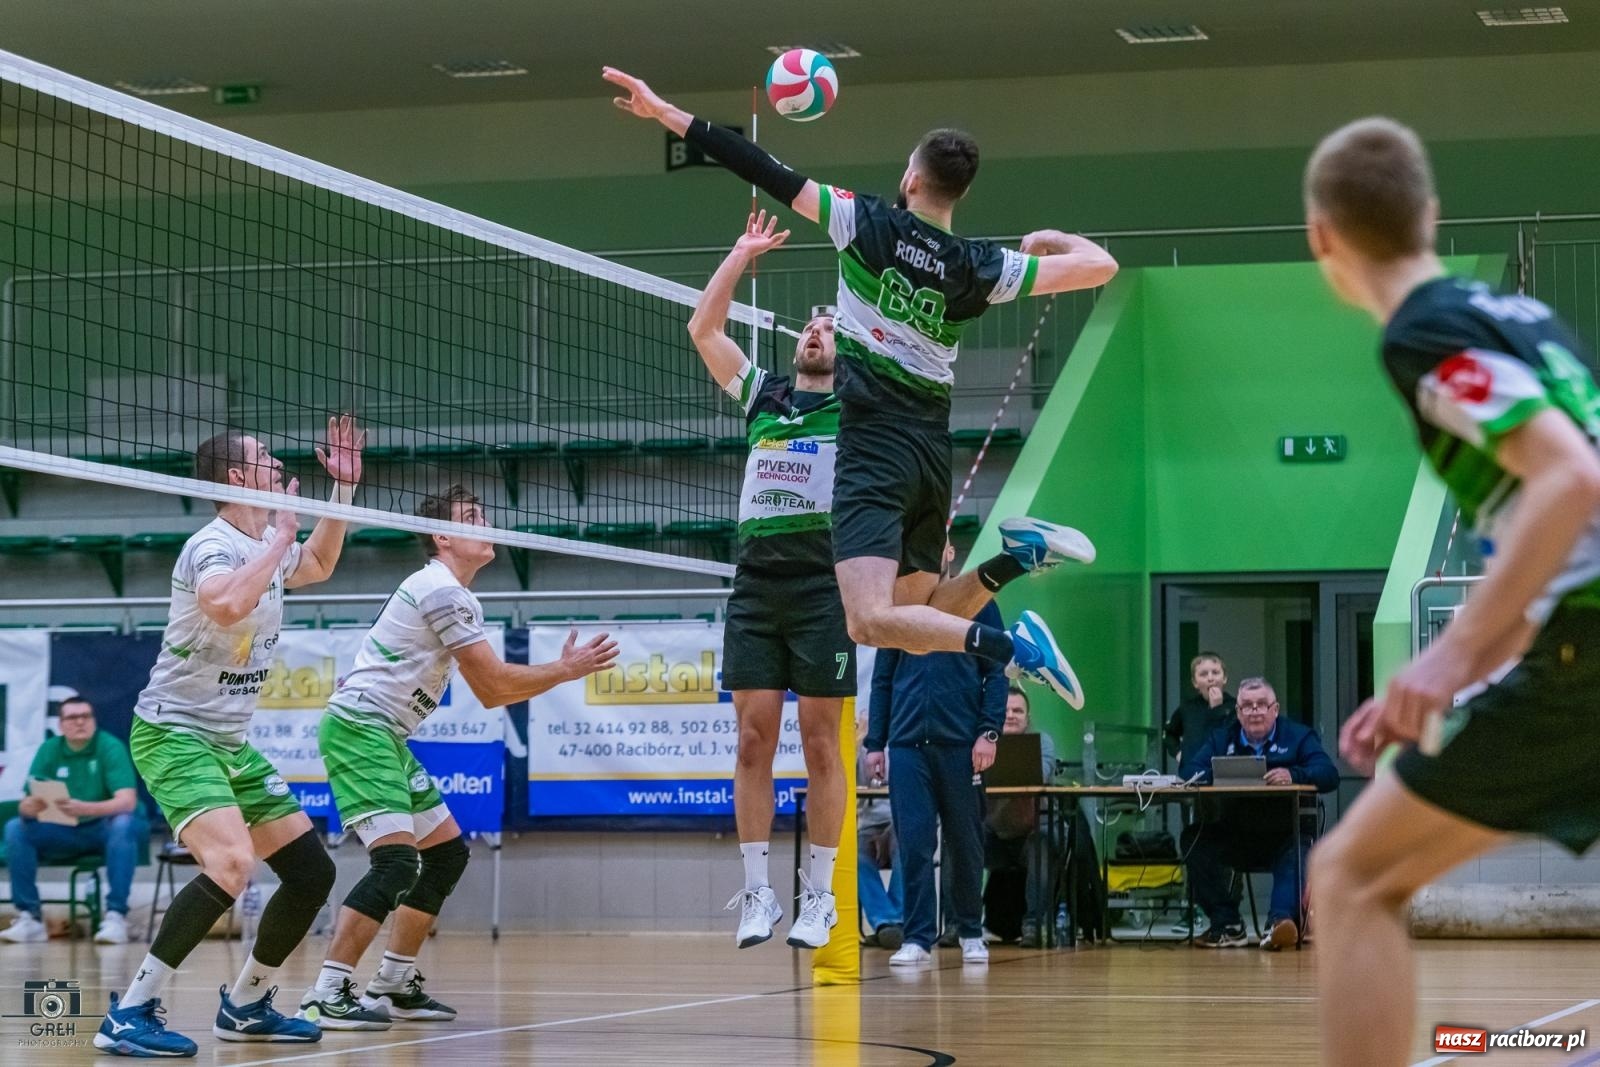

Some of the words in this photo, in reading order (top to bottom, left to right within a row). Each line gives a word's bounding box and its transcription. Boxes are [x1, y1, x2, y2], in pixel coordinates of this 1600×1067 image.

[758, 459, 811, 475] PIVEXIN
[757, 472, 809, 484] TECHNOLOGY
[836, 652, 848, 680] 7
[548, 721, 570, 735] tel.
[574, 722, 591, 735] 32
[595, 722, 624, 734] 414
[628, 721, 646, 735] 92
[650, 720, 673, 735] 88,
[680, 721, 708, 735] 502
[558, 743, 613, 757] 47-400
[616, 742, 685, 757] Racibórz,
[688, 742, 706, 756] ul.
[710, 742, 721, 756] J.
